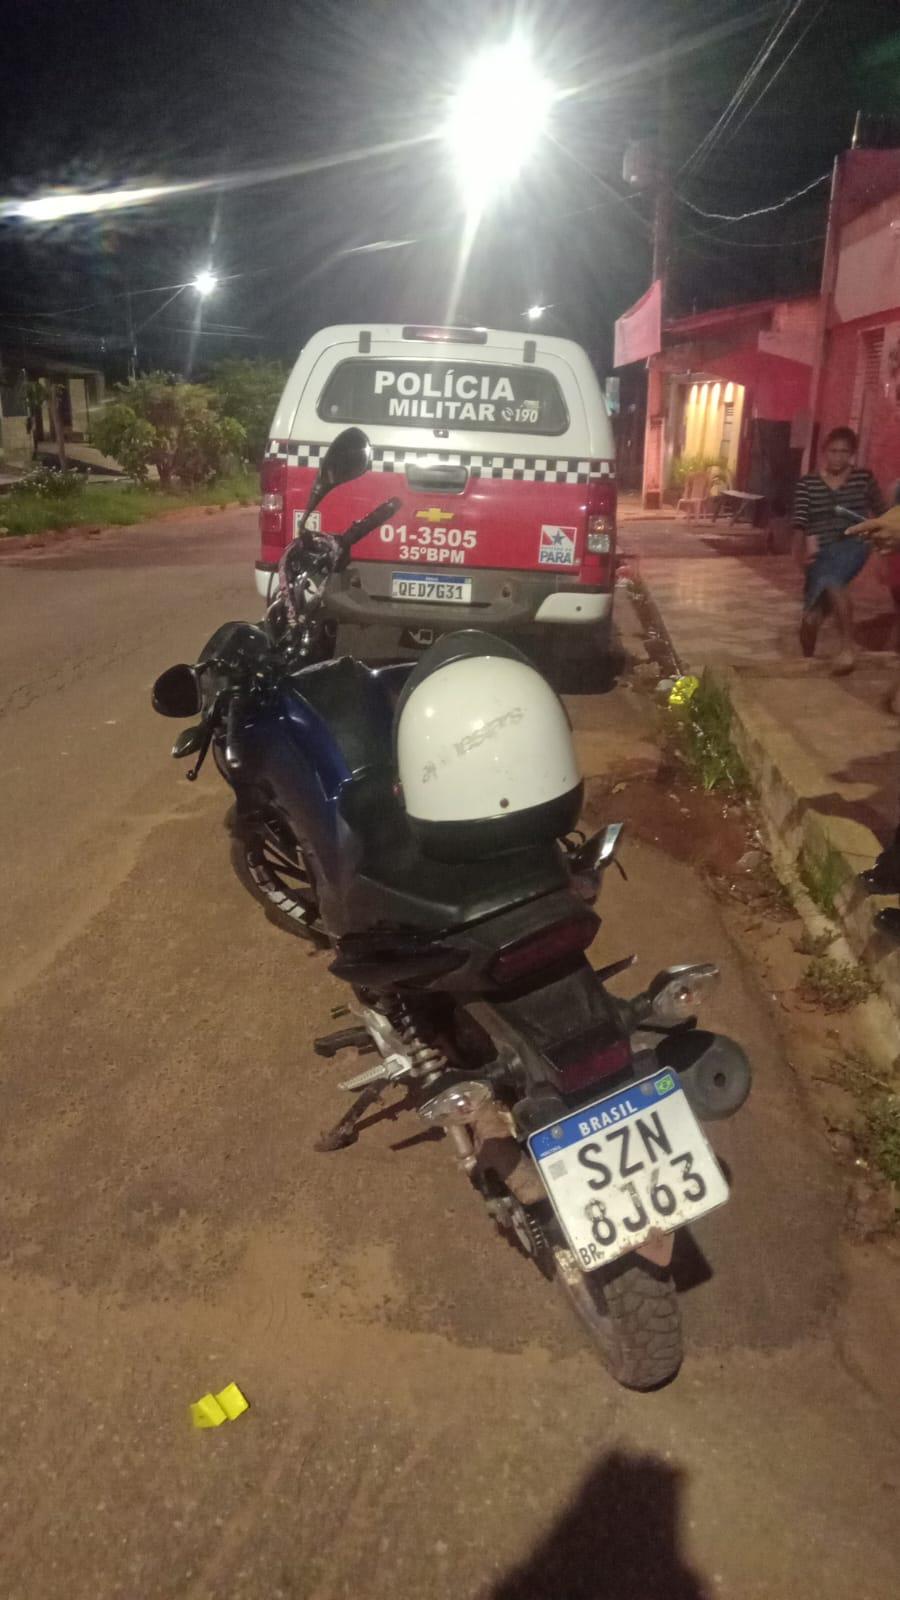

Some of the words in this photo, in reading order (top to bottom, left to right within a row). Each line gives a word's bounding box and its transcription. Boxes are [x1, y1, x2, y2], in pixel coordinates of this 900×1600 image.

[374, 369, 515, 401] POLÍCIA
[389, 398, 496, 422] MILITAR
[515, 408, 539, 424] 190
[380, 524, 478, 549] 01-3505
[398, 582, 464, 600] QED7G31
[578, 1100, 639, 1136] BRASIL
[577, 1110, 673, 1191] SZN
[584, 1151, 707, 1247] 8J63
[579, 1243, 602, 1267] BR
